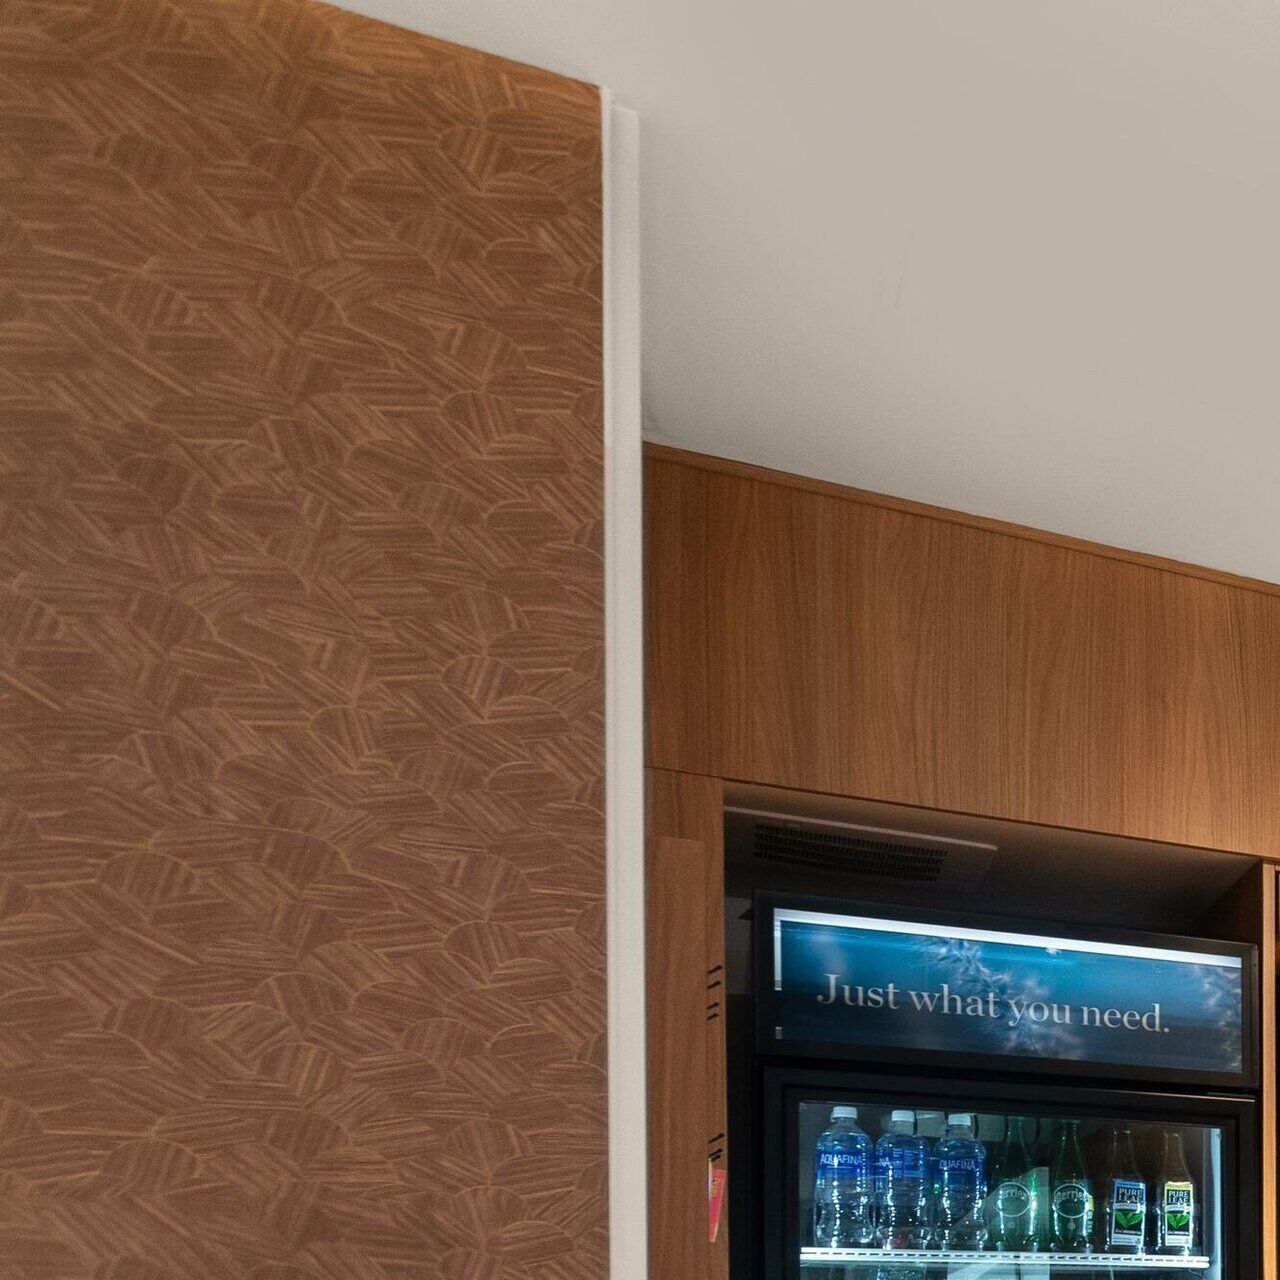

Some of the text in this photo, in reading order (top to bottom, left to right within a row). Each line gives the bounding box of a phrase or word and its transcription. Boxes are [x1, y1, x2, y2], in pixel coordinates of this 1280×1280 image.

[817, 973, 1171, 1034] Just what you need.
